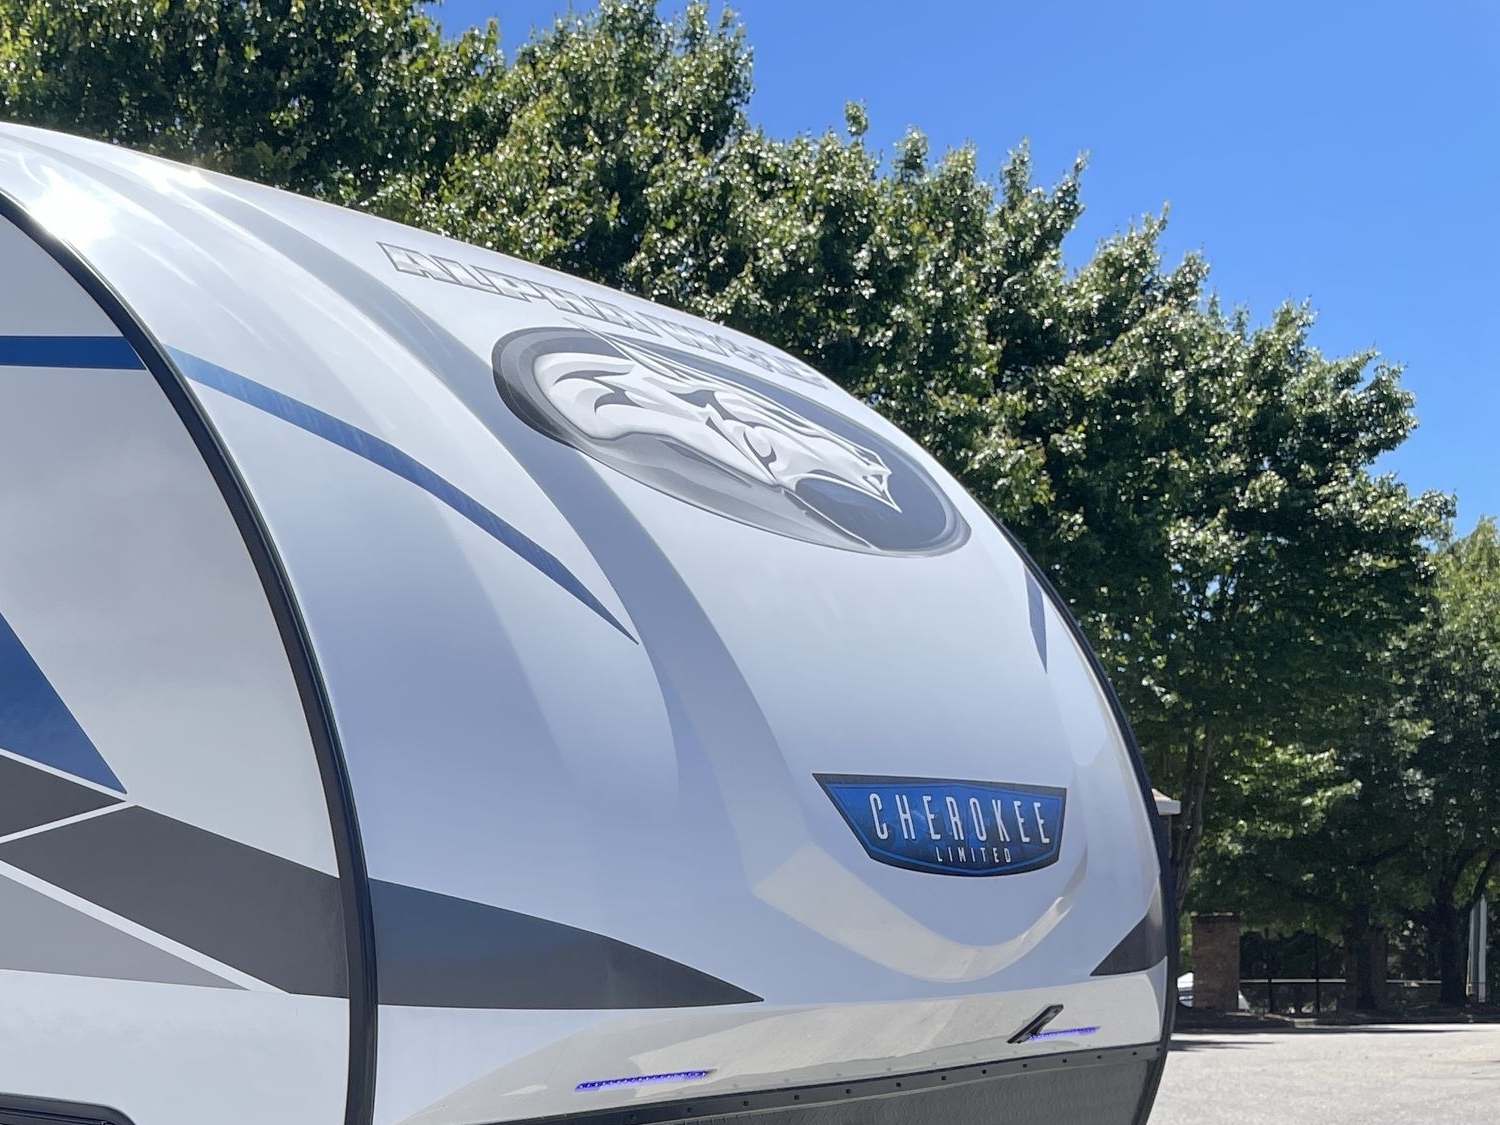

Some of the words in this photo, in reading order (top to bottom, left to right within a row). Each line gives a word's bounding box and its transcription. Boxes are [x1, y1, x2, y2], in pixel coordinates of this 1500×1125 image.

[377, 241, 662, 338] ALPHA
[869, 793, 1050, 844] CHEROKEE
[936, 847, 1011, 863] LIMITED
